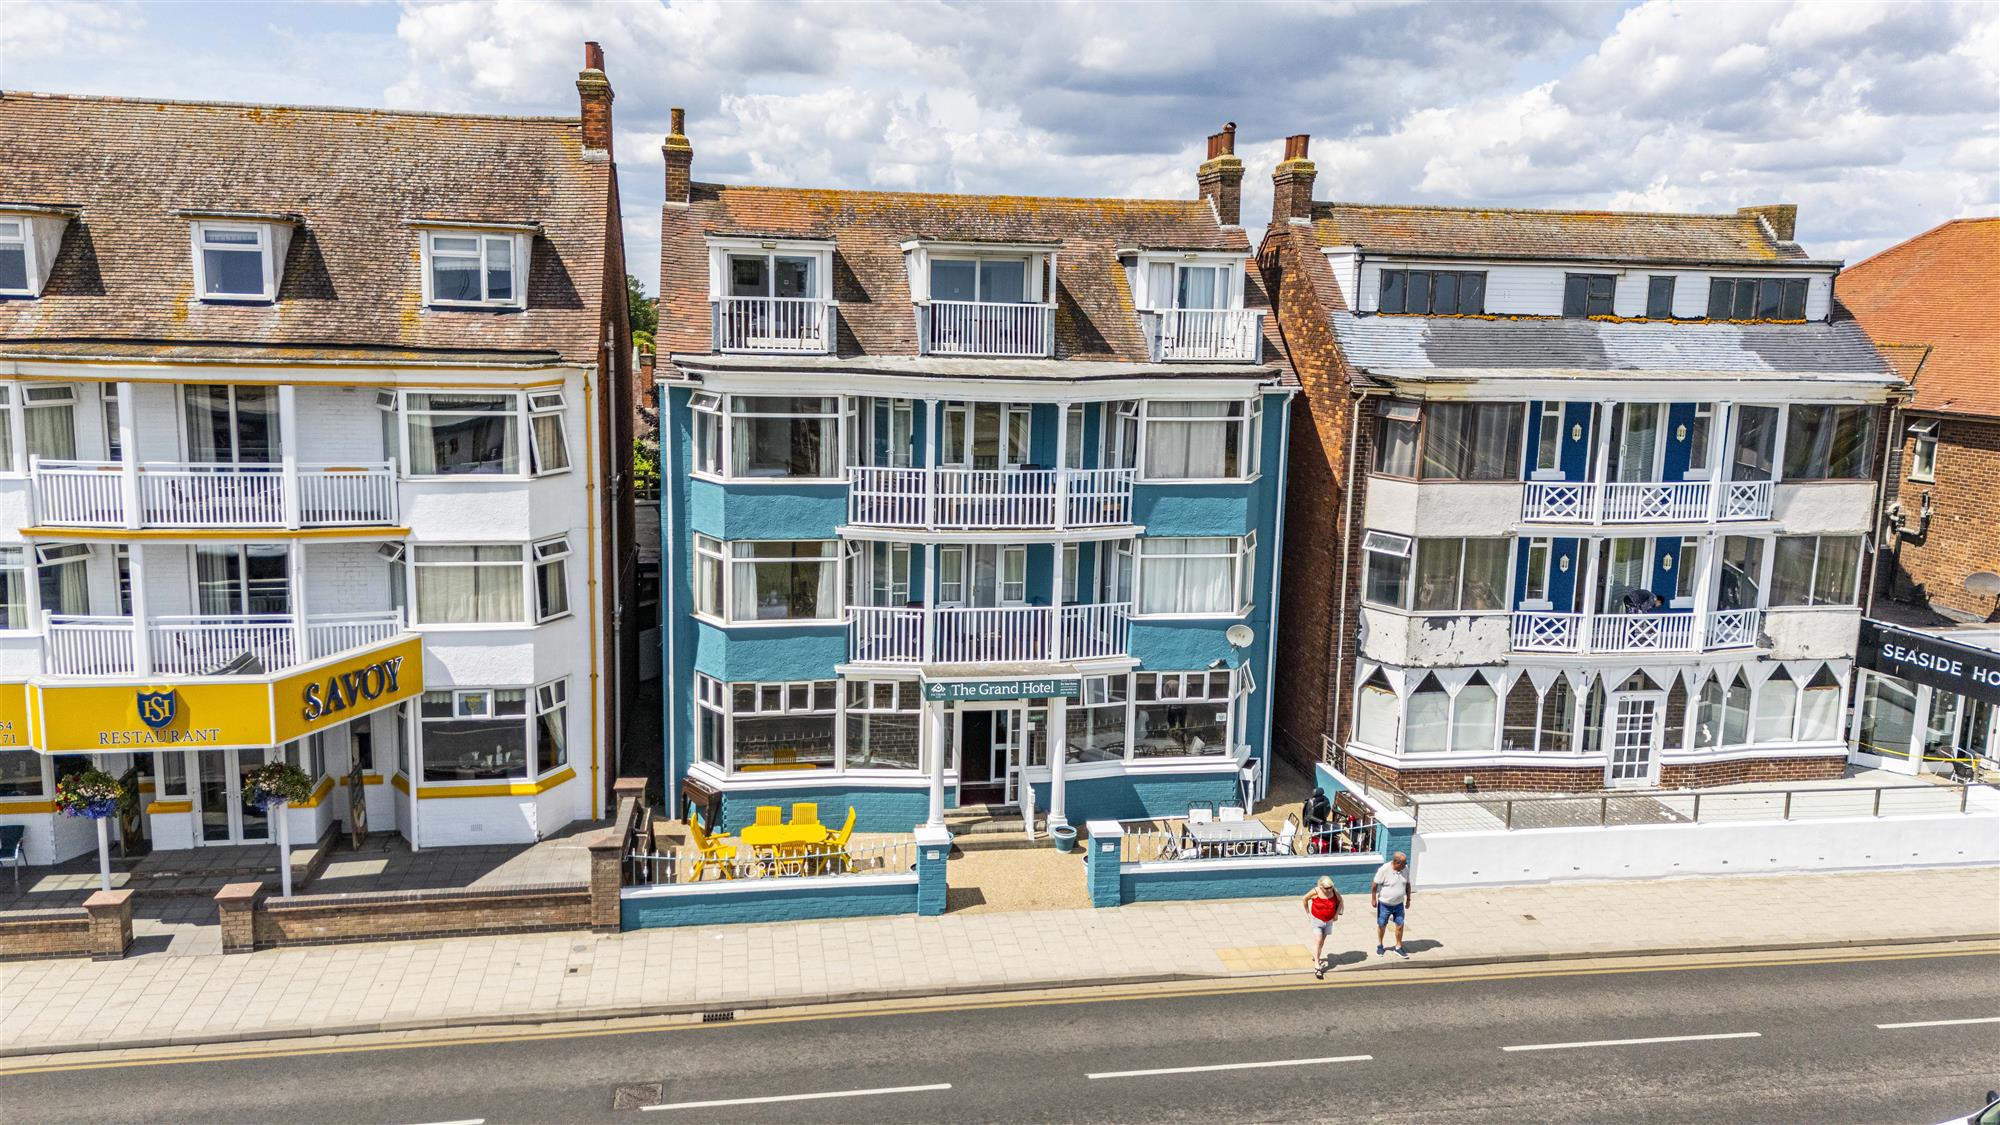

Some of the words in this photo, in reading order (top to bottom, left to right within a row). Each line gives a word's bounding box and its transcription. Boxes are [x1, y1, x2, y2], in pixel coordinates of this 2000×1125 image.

[1883, 644, 1962, 676] SEASIDE
[1972, 666, 2000, 686] HO
[304, 656, 405, 722] SAVOY
[951, 684, 977, 697] The
[979, 682, 1019, 696] Grand
[1022, 680, 1055, 695] Hotel
[99, 728, 220, 745] RESTAURANT
[1226, 840, 1275, 857] HOTEL
[744, 860, 801, 878] GRAND
